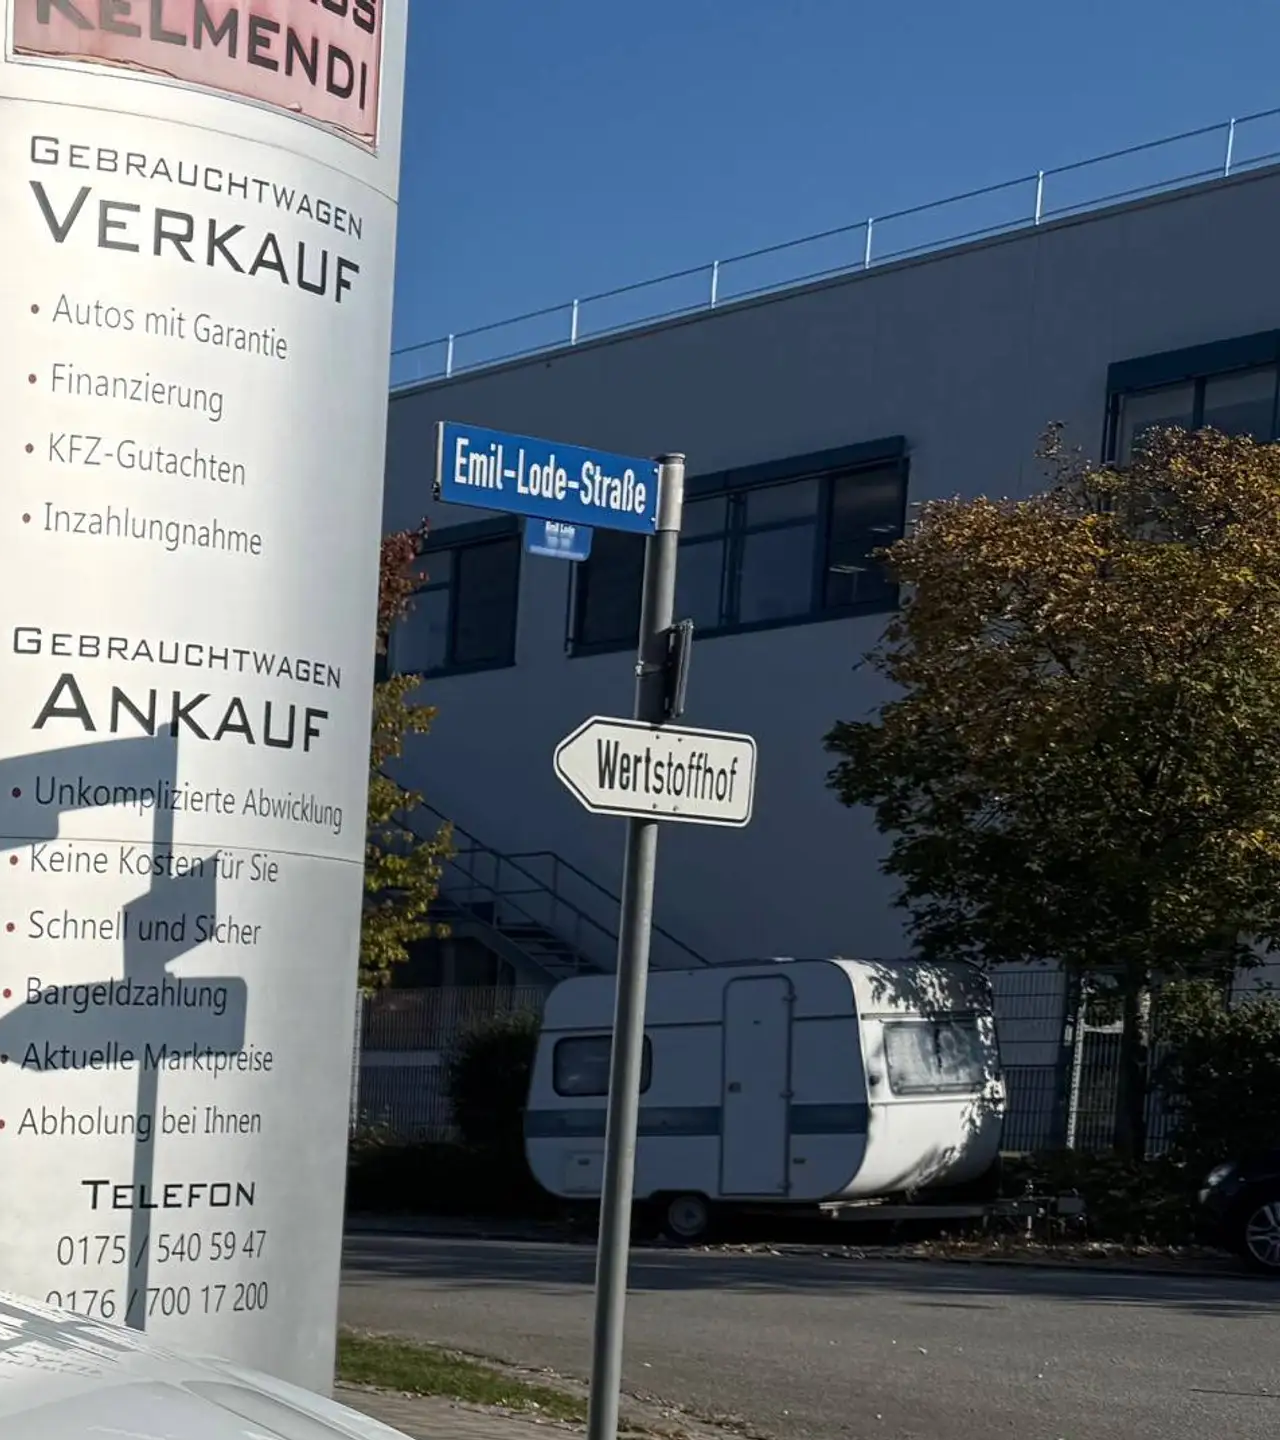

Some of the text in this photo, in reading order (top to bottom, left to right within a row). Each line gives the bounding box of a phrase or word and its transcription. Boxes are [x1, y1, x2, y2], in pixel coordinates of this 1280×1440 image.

[30, 135, 363, 240] GEBRAUCHTWAGEN
[29, 180, 361, 304] VERKAUF
[52, 294, 288, 360] Autos mit Garantie
[50, 363, 224, 422] Finanzierung
[48, 432, 246, 486] KFZ-Gutachten
[454, 436, 647, 514] Emil-Lode-Straße
[43, 501, 263, 556] Inzahlungnahme
[13, 626, 342, 690] GEBRAUCHTWAGEN
[31, 672, 329, 752] ANKAUF
[597, 738, 739, 803] Wertstoffhof
[34, 776, 343, 836] Unkomplizierte Abwicklung
[29, 842, 279, 883] Keine Kosten für Sie
[28, 910, 262, 945] Schnell und Sicher
[25, 977, 228, 1015] Bargeldzahlung
[20, 1041, 274, 1079] Aktuelle Marktpreise
[17, 1105, 262, 1142] Abholung bei Ihnen
[81, 1179, 256, 1210] TELEFON
[56, 1234, 127, 1266] 0175
[156, 1231, 202, 1263] 540
[209, 1230, 237, 1261] 59
[241, 1230, 267, 1259] 47
[146, 1285, 191, 1316] 700
[200, 1284, 227, 1314] 17
[233, 1281, 269, 1312] 200
